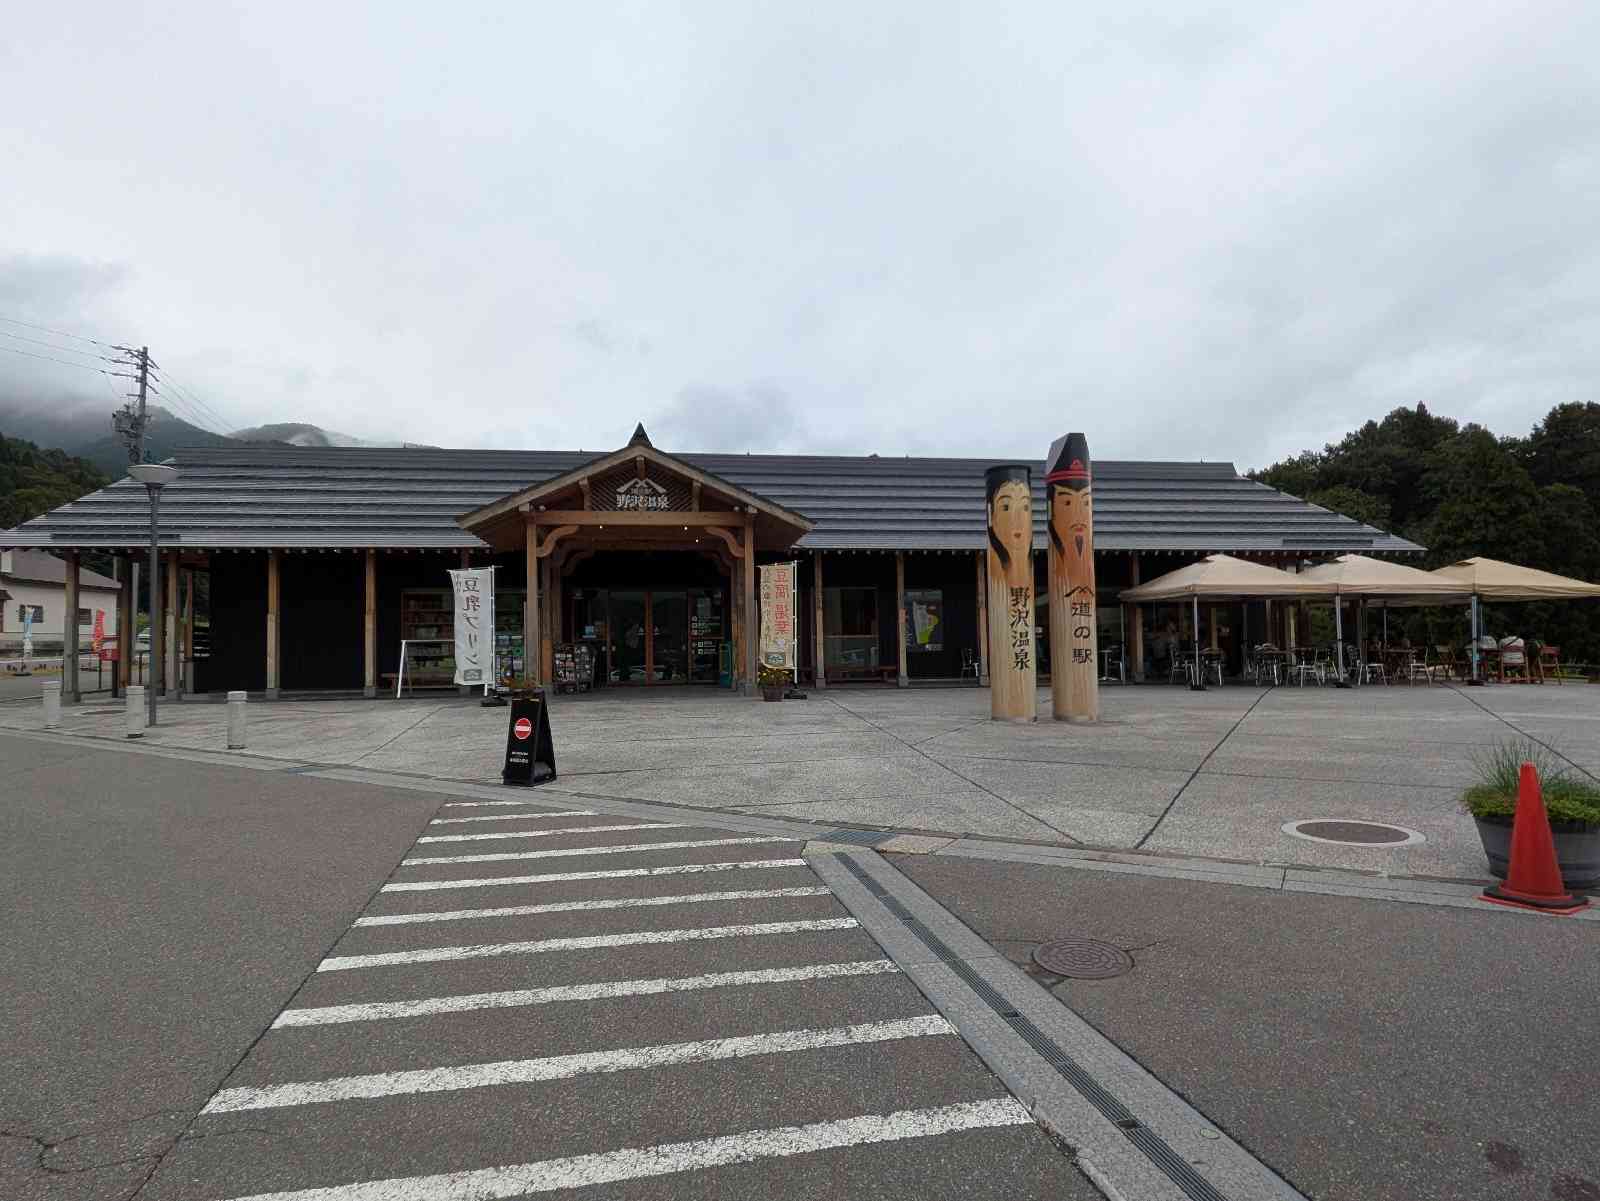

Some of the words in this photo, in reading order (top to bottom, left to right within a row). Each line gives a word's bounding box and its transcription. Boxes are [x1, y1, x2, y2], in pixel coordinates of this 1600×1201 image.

[1009, 587, 1031, 670] 野沢温泉
[1071, 602, 1093, 664] 道の駅
